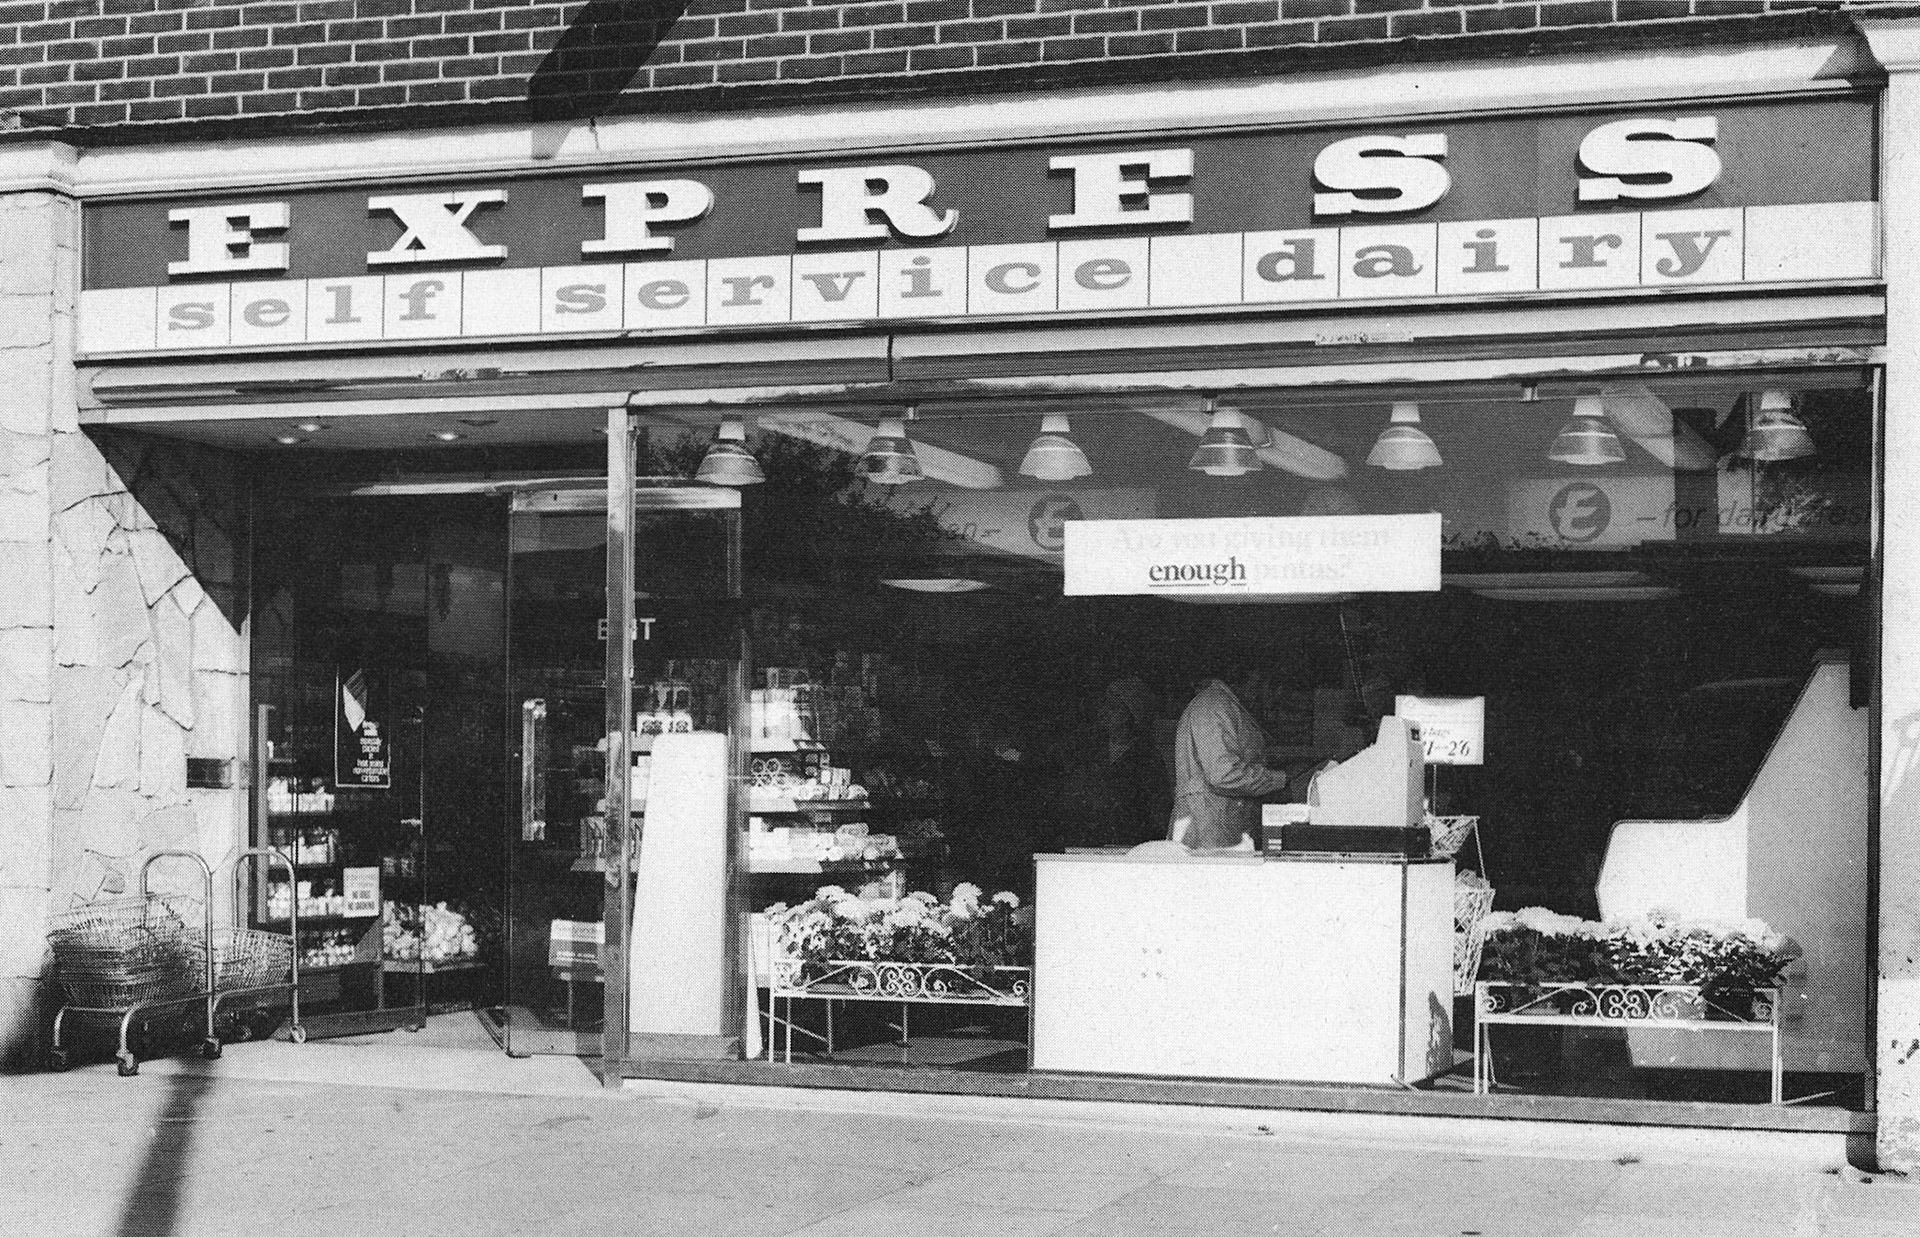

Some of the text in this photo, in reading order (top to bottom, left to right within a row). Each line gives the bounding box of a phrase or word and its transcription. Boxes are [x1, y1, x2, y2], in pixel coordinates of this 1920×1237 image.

[168, 117, 1721, 275] EXPRESS
[168, 228, 1733, 332] self service dairy
[1148, 555, 1247, 585] enough
